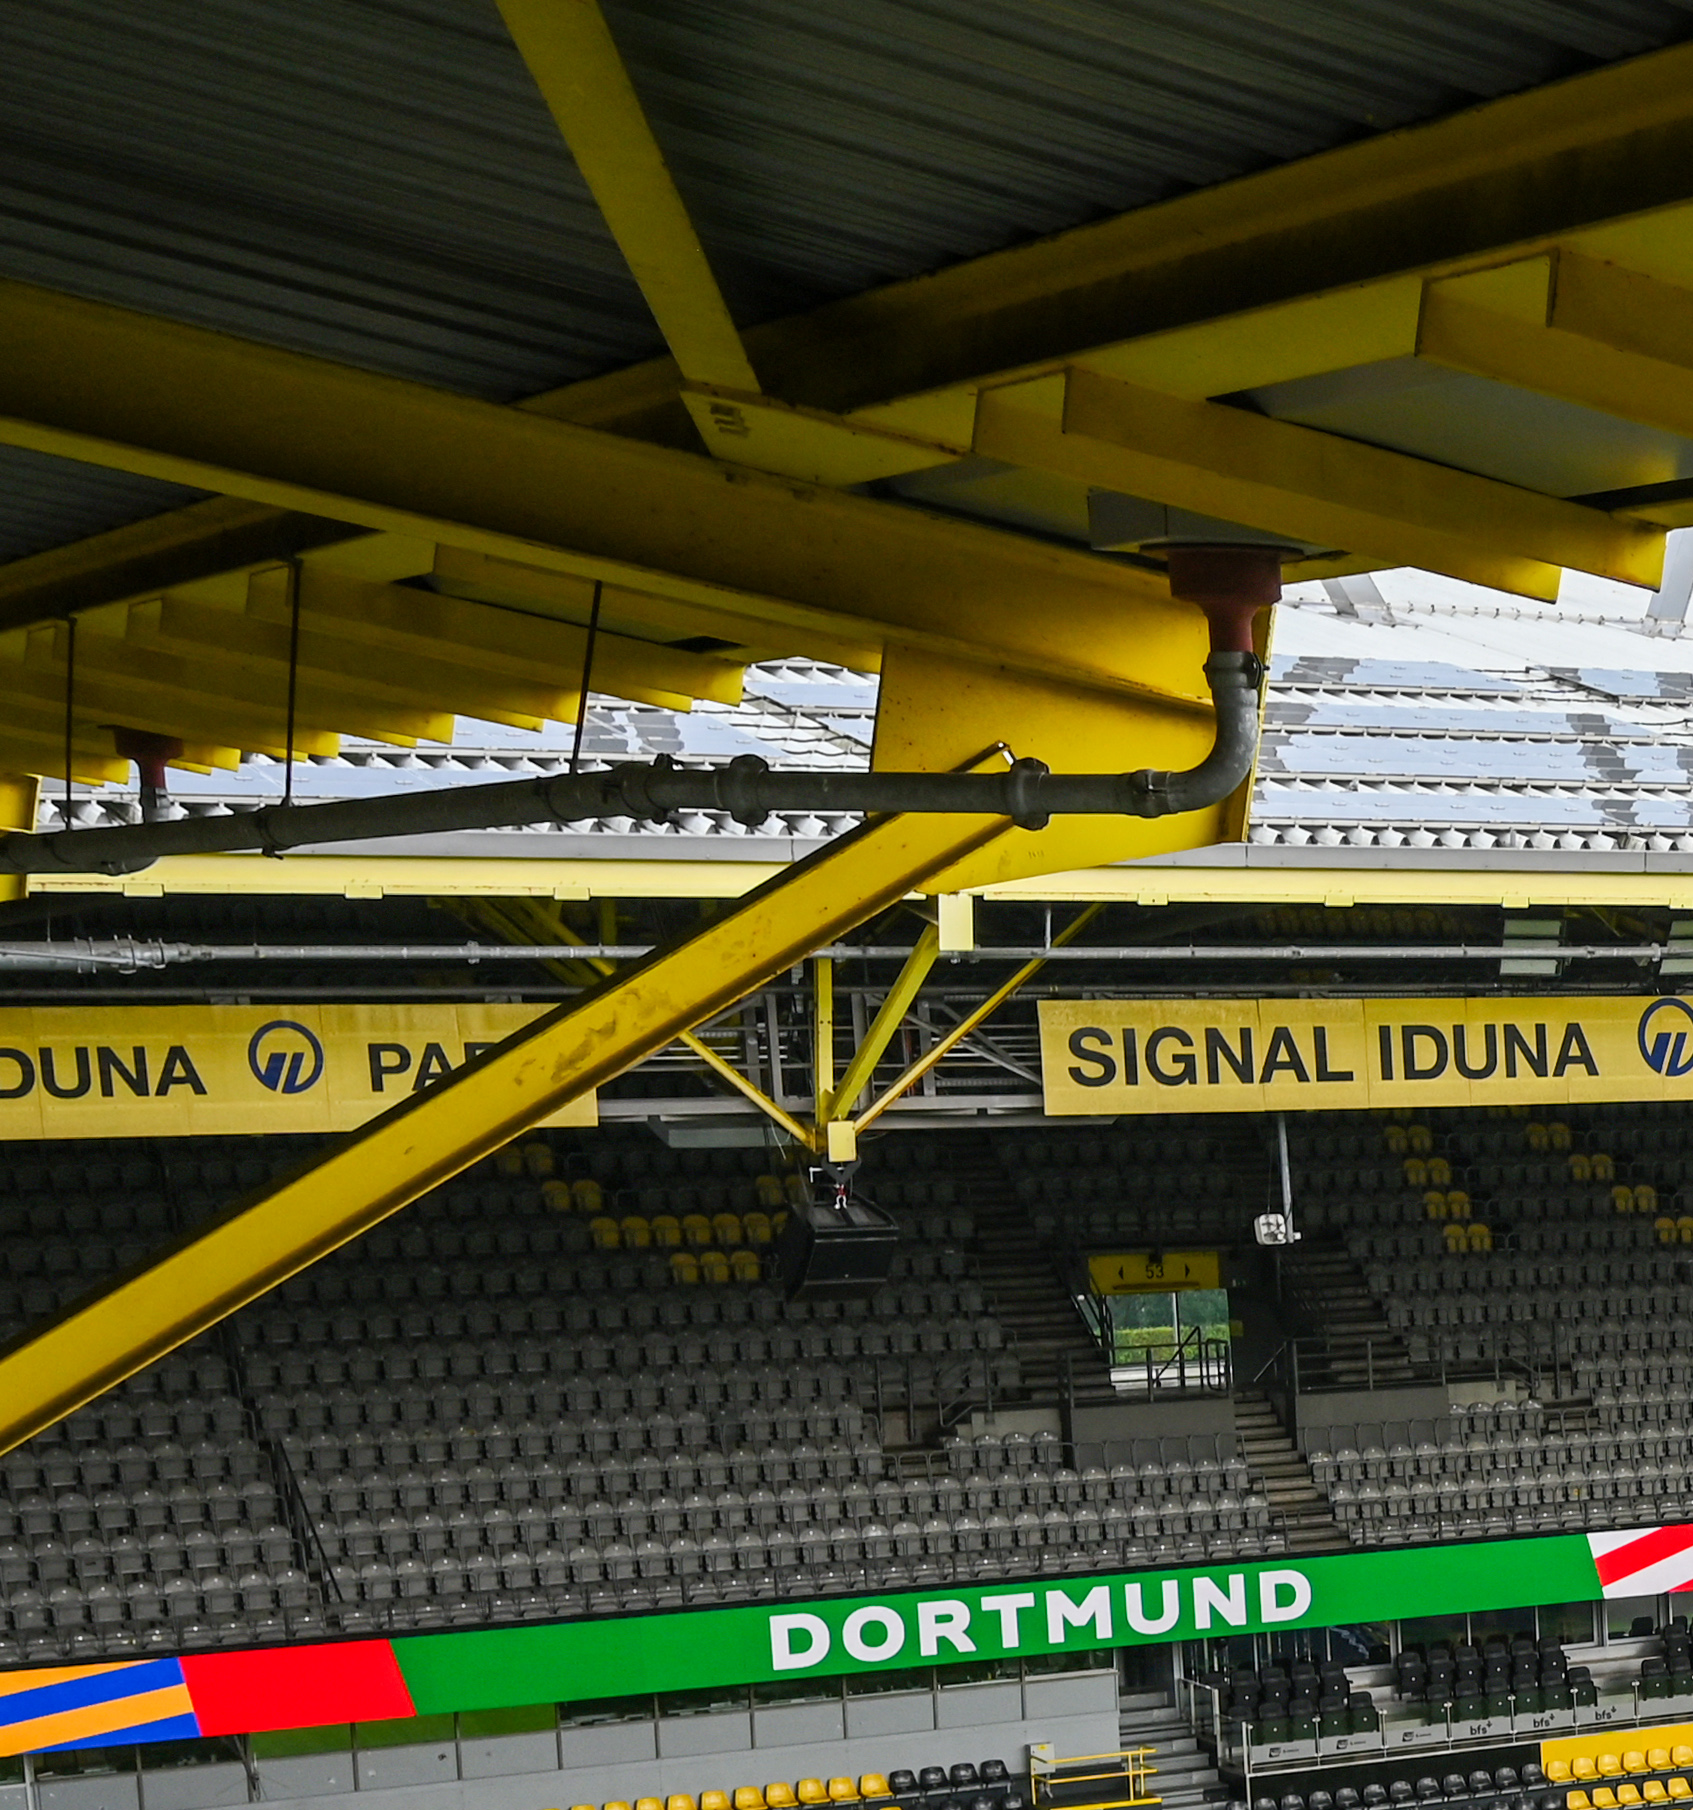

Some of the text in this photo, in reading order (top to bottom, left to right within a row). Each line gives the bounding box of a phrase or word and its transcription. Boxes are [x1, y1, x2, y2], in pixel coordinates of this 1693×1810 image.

[1068, 1025, 1354, 1087] SIGNAL
[1379, 1022, 1599, 1081] IDUNA
[1145, 1264, 1164, 1279] 53
[769, 1568, 1314, 1671] DORTMUND
[1594, 1709, 1612, 1721] bfs
[1532, 1717, 1550, 1729] bfs
[1469, 1724, 1488, 1736] bfs
